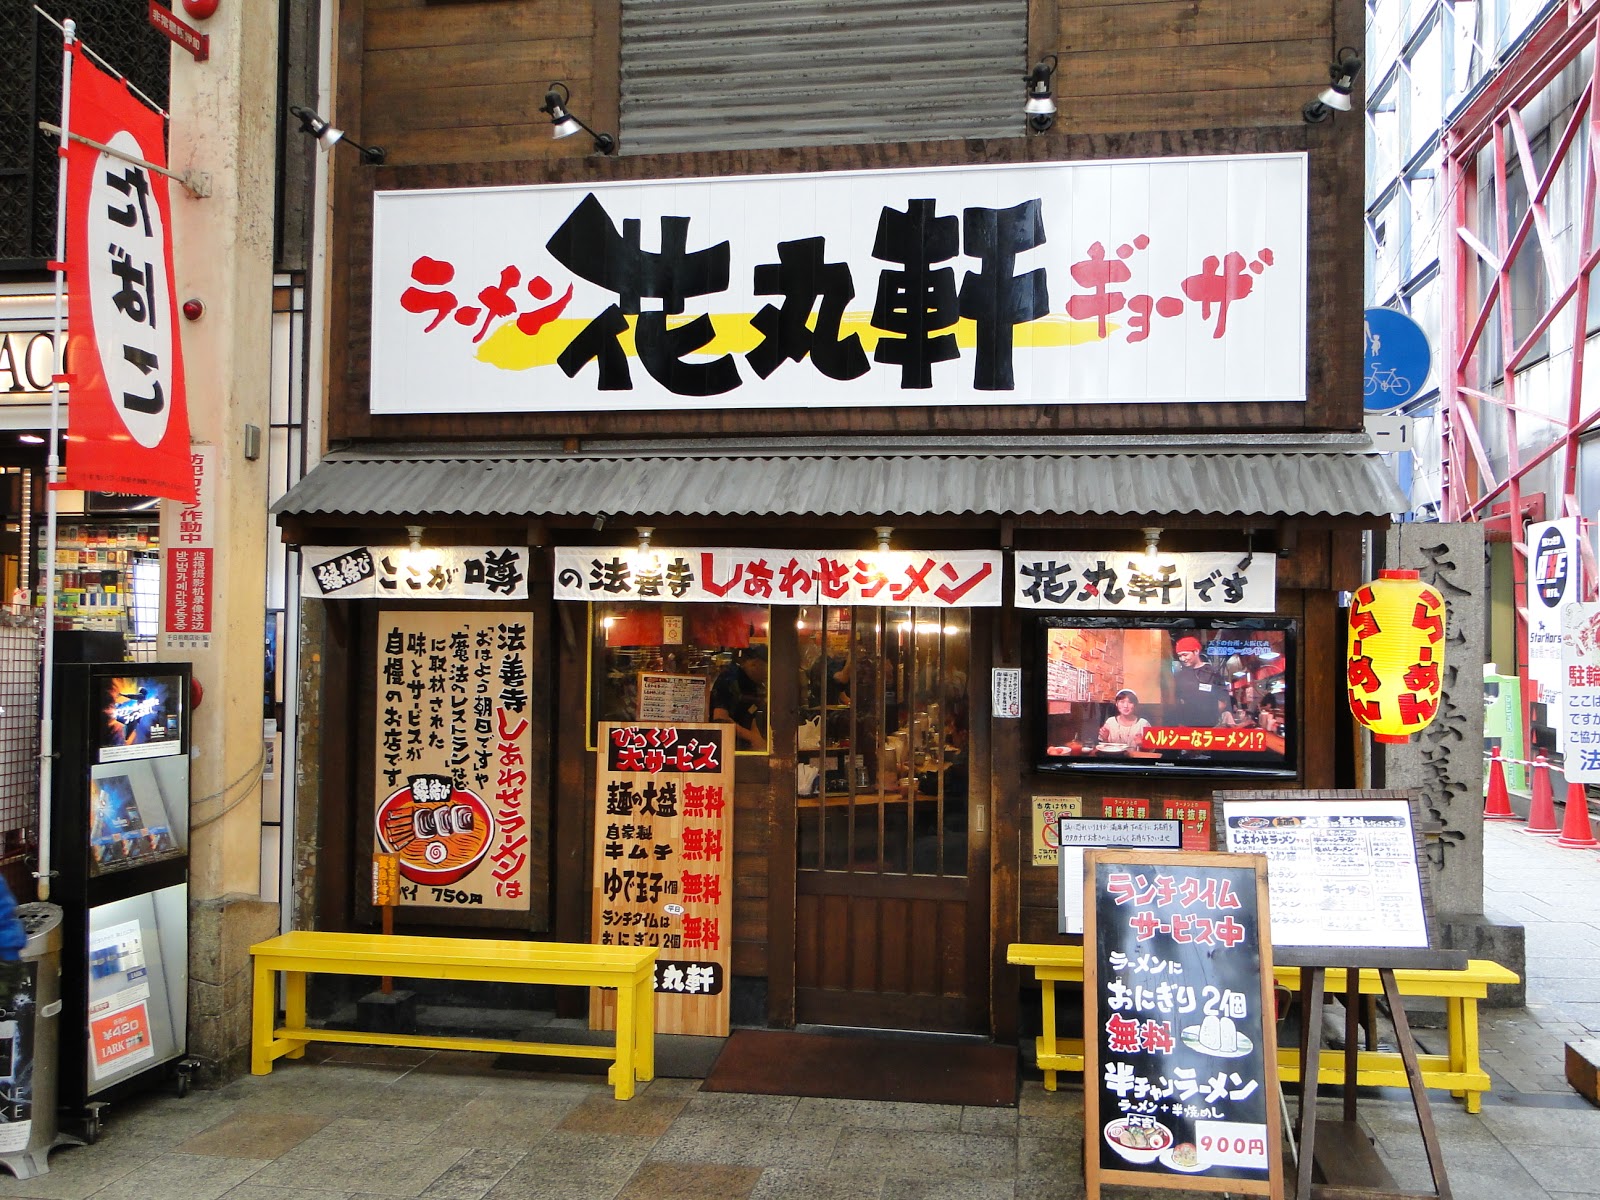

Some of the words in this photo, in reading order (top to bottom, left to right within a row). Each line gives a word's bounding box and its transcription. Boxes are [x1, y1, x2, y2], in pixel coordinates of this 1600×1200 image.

[399, 255, 575, 343] ラーメン
[544, 192, 1047, 396] 花丸軒
[1066, 234, 1275, 343] ギョーザ
[318, 551, 371, 591] 縁結び
[379, 548, 524, 596] ここが噂
[1020, 560, 1249, 605] 花丸軒です
[1349, 586, 1382, 725] らーめん
[1530, 633, 1562, 643] StarHors
[1398, 589, 1444, 725] らーめん
[406, 632, 427, 762] 味とサービスが
[428, 639, 448, 749] に取材された
[611, 725, 679, 749] びっくり
[1144, 730, 1264, 749] ヘルシーなラーメン!?
[616, 738, 720, 775] 大サービス
[413, 778, 451, 803] 縁結び
[606, 780, 678, 817] 麺の大盛
[682, 782, 726, 819] 無料
[1104, 805, 1146, 818] 相性抜群
[1165, 808, 1207, 821] 相性抜群
[605, 823, 653, 841] 自家製
[605, 841, 673, 861] キムチ
[681, 827, 724, 862] 無料
[1233, 833, 1296, 844] しあわせラーメン
[431, 888, 483, 905] 750円
[681, 870, 722, 905] 無料
[1107, 873, 1241, 909] ランチタイム
[602, 909, 671, 928] ランチタイムは
[681, 913, 720, 950] 無料
[1129, 911, 1245, 948] サービス中
[654, 964, 714, 993] 丸軒
[1109, 951, 1183, 974] ラーメンに
[102, 1019, 139, 1041] ¥420
[1105, 1013, 1176, 1055] 無料
[102, 1040, 126, 1058] LARK
[1104, 1061, 1258, 1104] 半チャンラーメン
[1200, 1135, 1265, 1156] 900円
